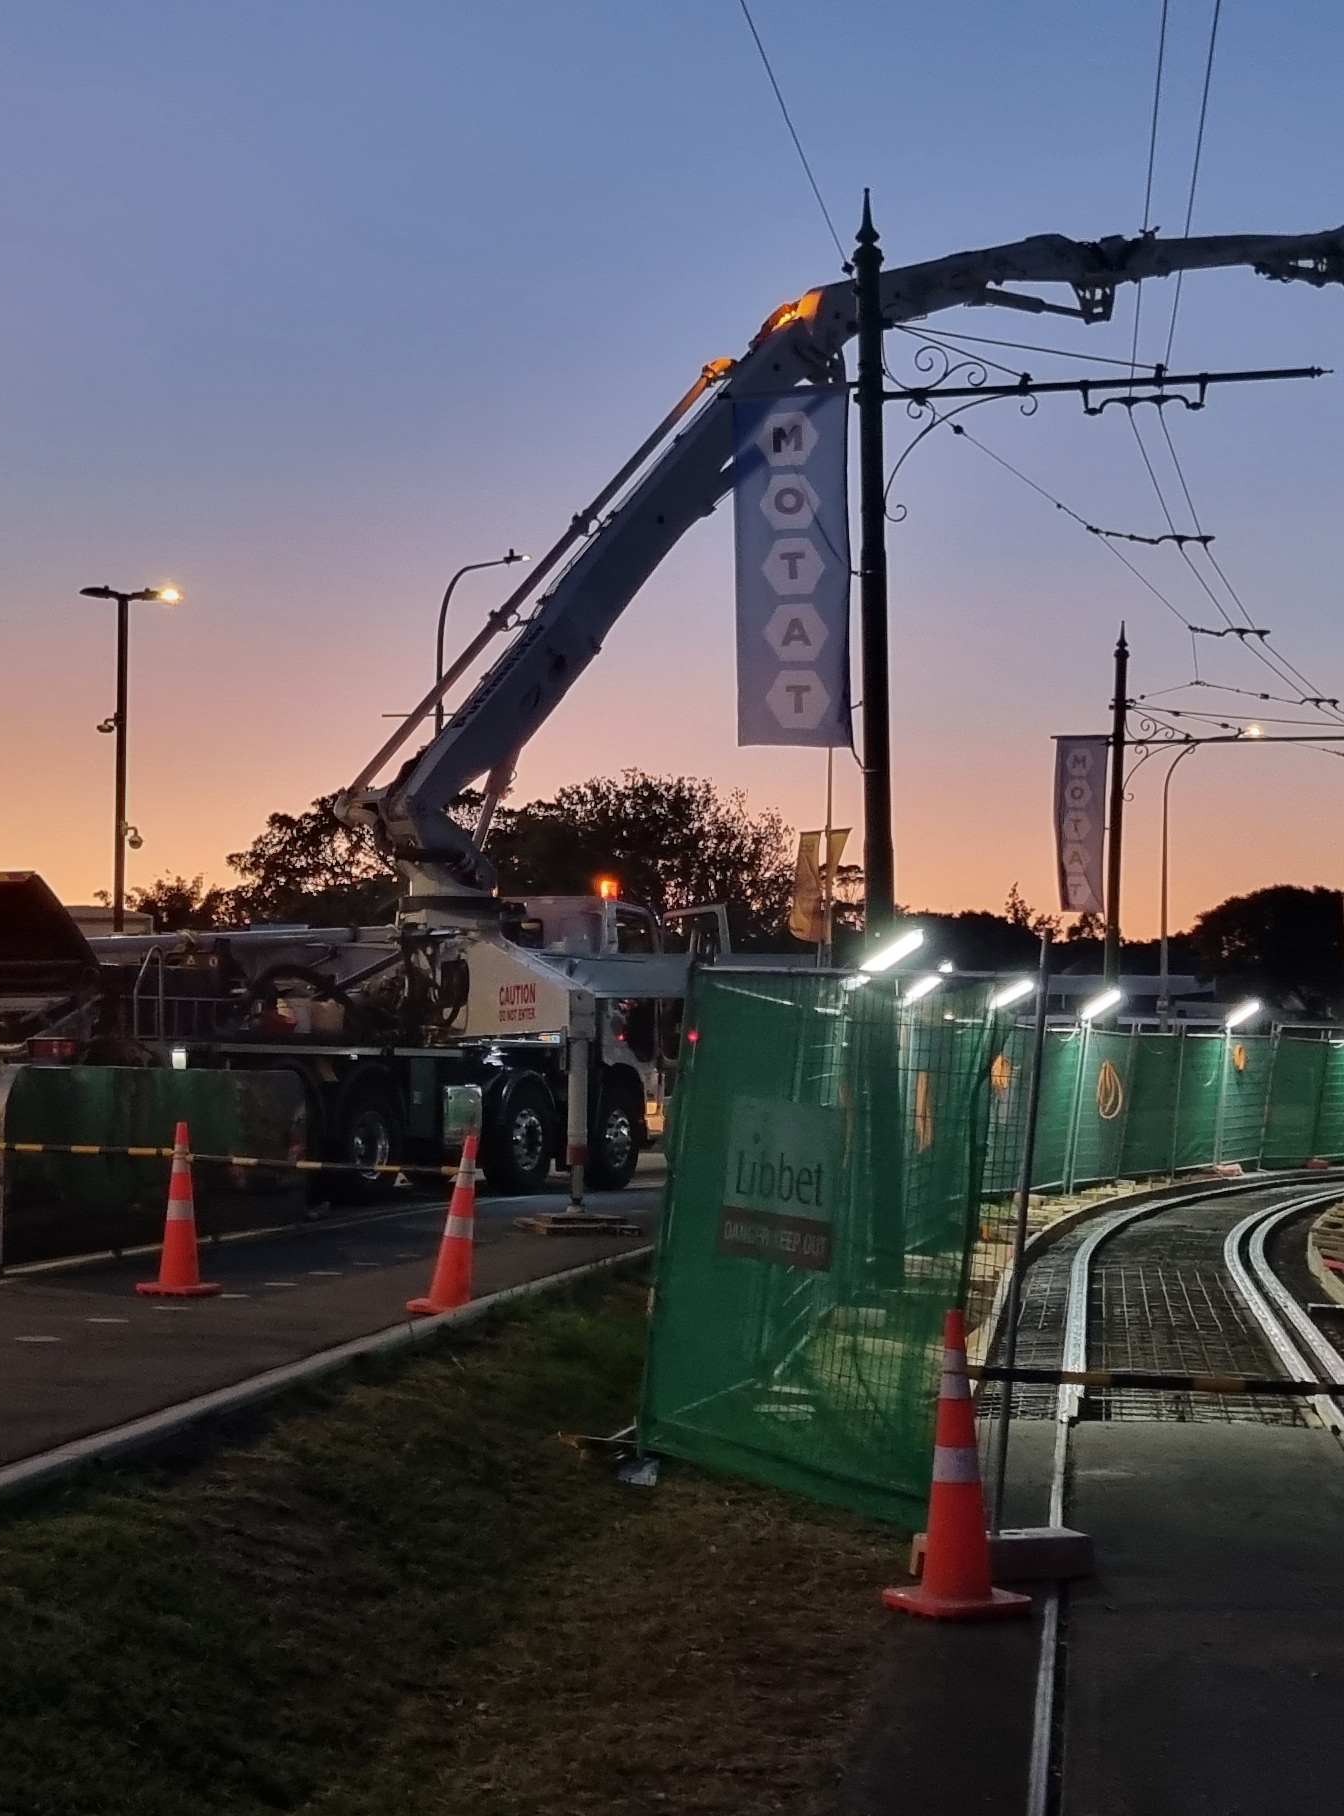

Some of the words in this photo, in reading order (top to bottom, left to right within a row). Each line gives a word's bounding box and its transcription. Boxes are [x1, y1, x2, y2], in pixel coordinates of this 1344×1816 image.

[772, 424, 811, 714] MOTAT
[1068, 755, 1086, 896] MOTAT
[499, 983, 536, 1006] CAUTION
[507, 1009, 518, 1021] NOT
[518, 1007, 536, 1021] ENTER
[735, 1133, 824, 1208] Libbet
[773, 1228, 801, 1252] EEP
[802, 1233, 829, 1258] OUT
